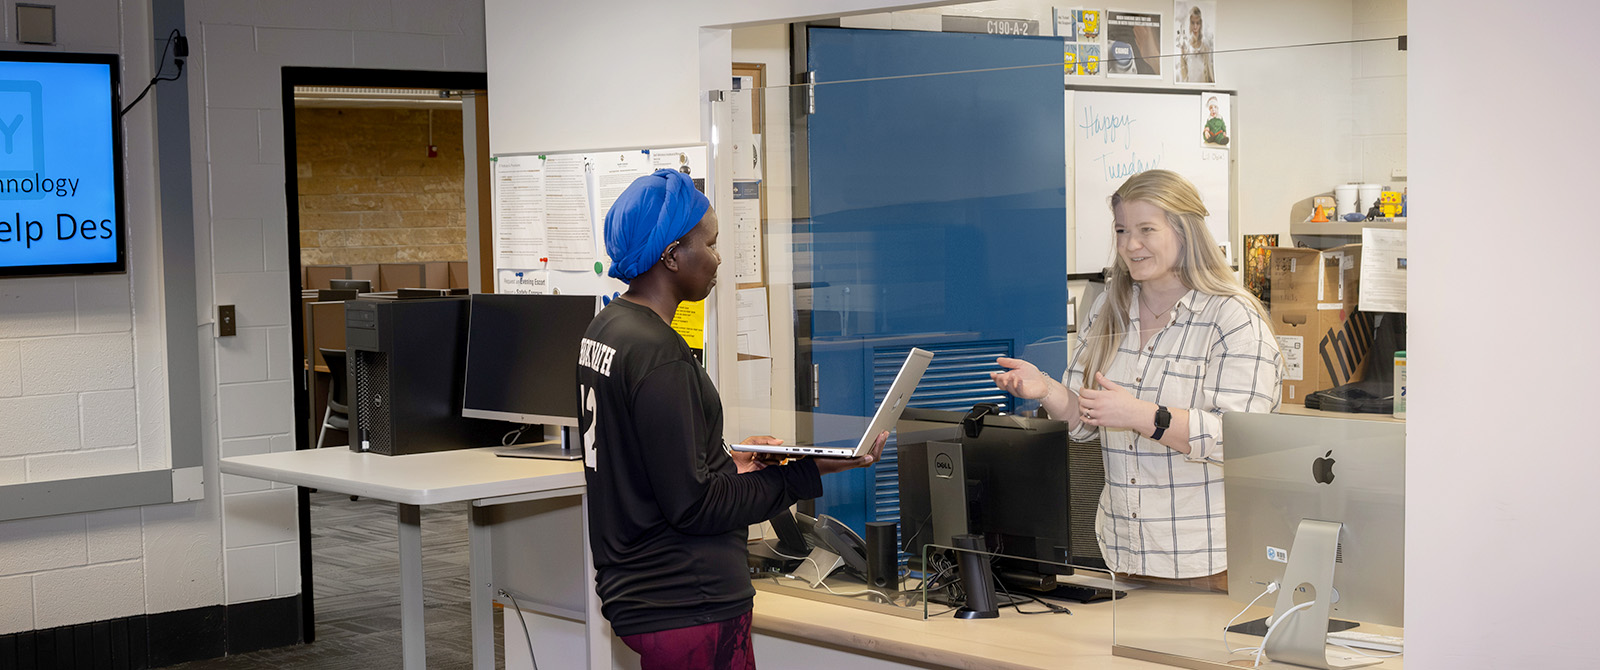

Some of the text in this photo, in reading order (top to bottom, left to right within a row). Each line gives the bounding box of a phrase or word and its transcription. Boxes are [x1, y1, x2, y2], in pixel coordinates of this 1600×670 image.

[987, 20, 1028, 35] C190-A-2
[1079, 105, 1136, 150] Happy
[57, 212, 113, 241] Des
